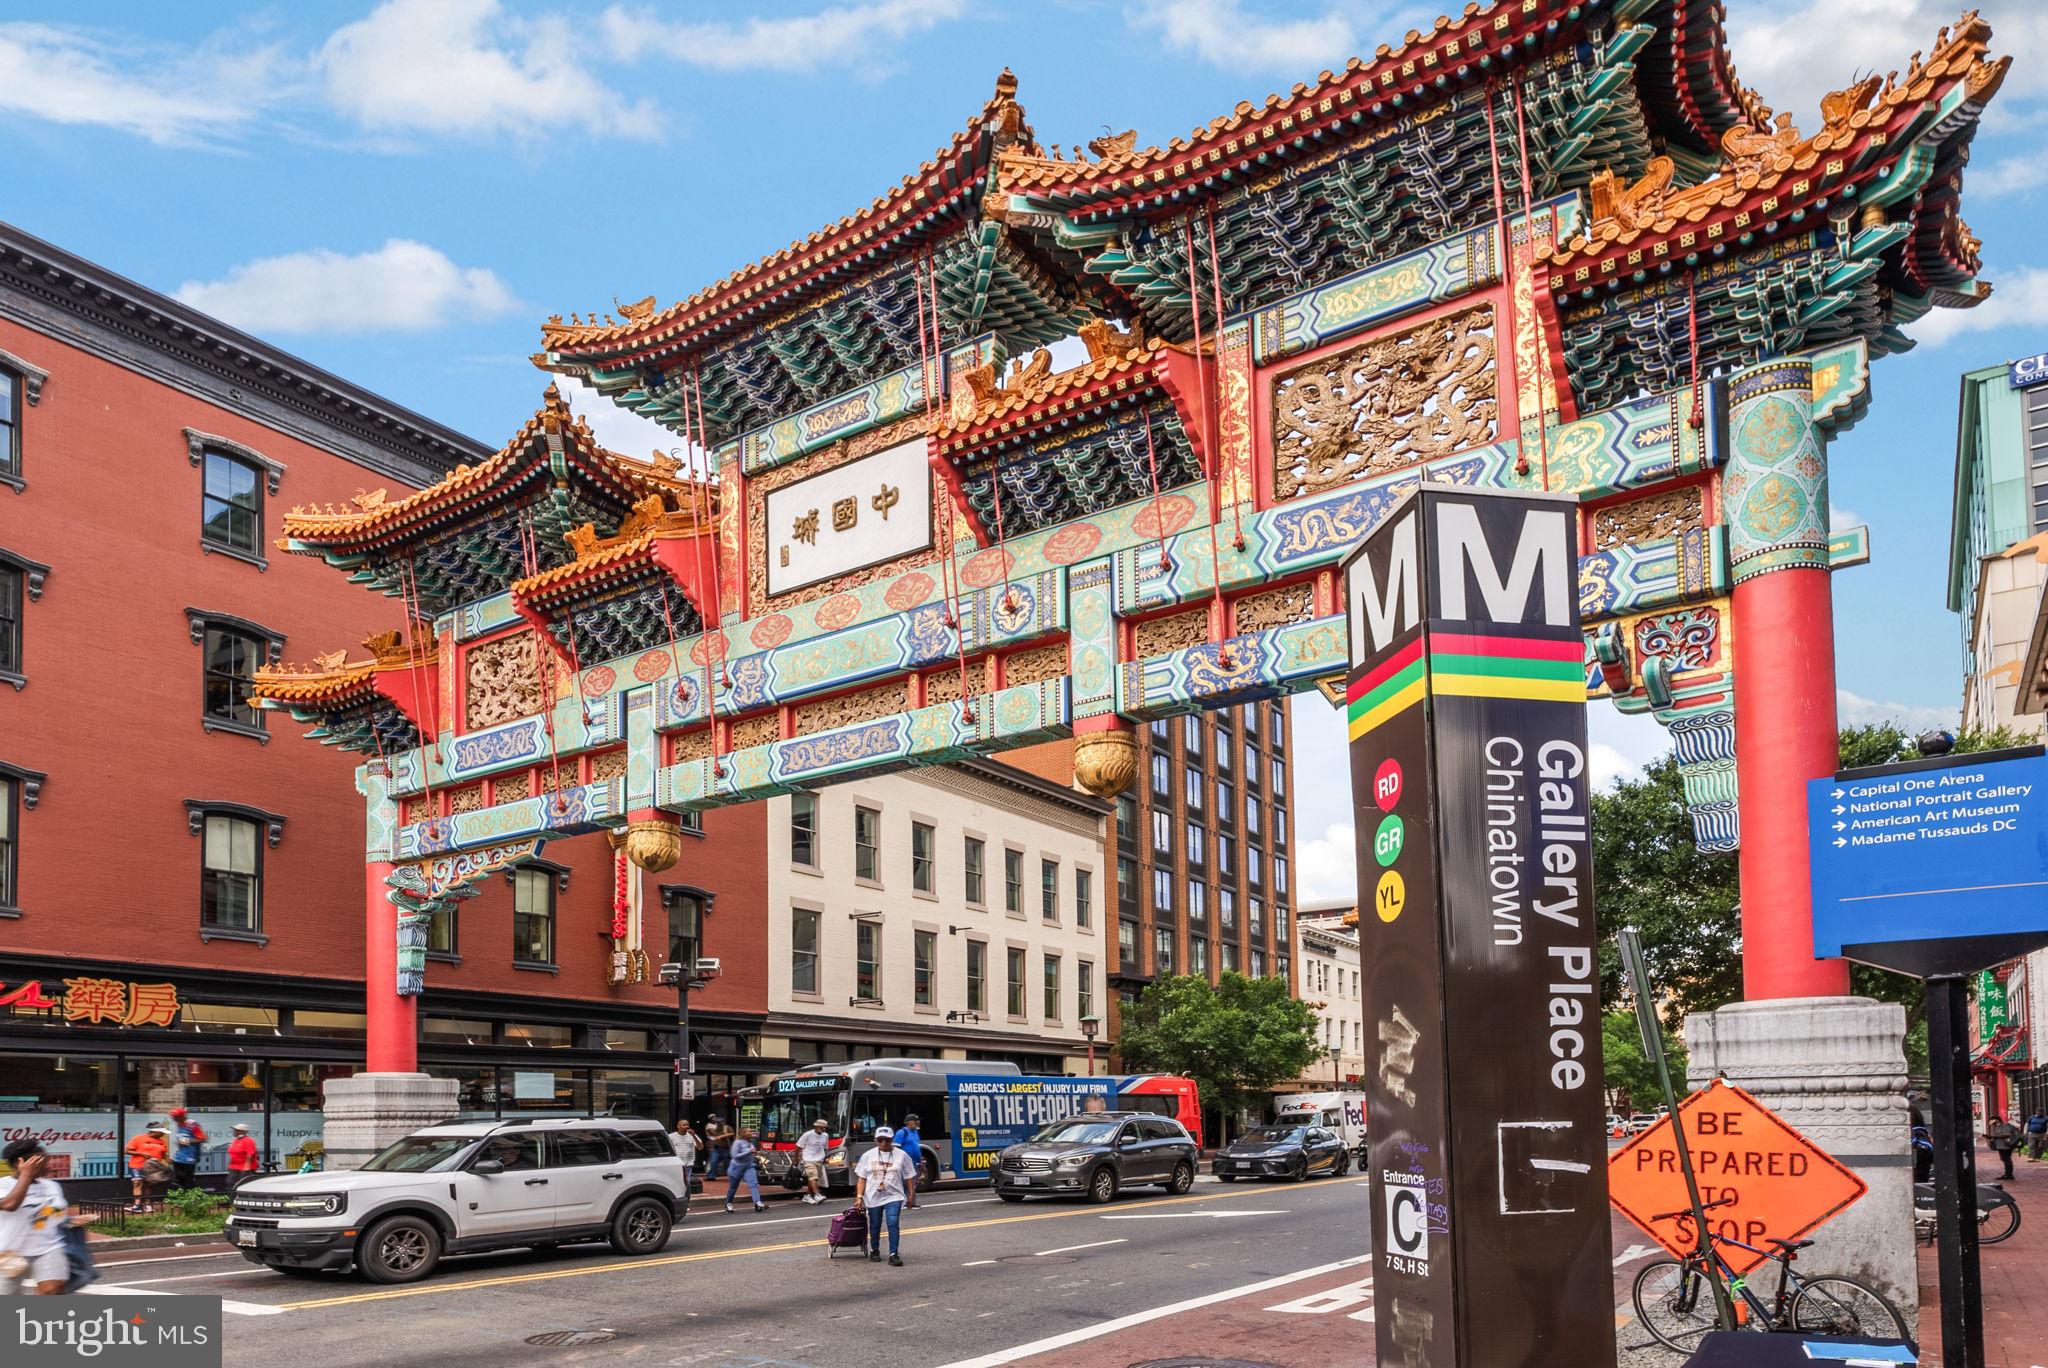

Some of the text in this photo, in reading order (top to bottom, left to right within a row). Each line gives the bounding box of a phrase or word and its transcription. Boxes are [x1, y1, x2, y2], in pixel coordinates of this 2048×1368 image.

[1436, 502, 1570, 626] M
[1350, 509, 1420, 669] M
[1378, 772, 1399, 800] RD
[1849, 773, 1985, 798] Capital One Arena
[1850, 784, 2033, 814] National Portrait Gallery
[1851, 803, 2020, 830] American Art Museum
[1377, 826, 1401, 856] GR
[1485, 737, 1525, 945] Chinatown
[1851, 819, 2017, 847] Madame Tussauds DC
[1379, 885, 1400, 909] YL
[1533, 740, 1592, 1090] Gallery Place
[64, 977, 181, 1027] 藥房
[779, 1079, 796, 1092] D2X
[796, 1080, 818, 1089] GALLERY
[958, 1083, 1108, 1094] AMERICA'S LARGEST INJURY LAW FIRM
[959, 1095, 991, 1126] FOR
[994, 1095, 1025, 1125] THE
[1281, 1102, 1318, 1113] FedEx
[2, 1127, 118, 1146] Walgreens
[277, 1128, 313, 1138] Happy
[1697, 1111, 1743, 1136] BE
[1383, 1169, 1425, 1186] Entrance
[233, 1199, 282, 1208] BRONCO
[1700, 1186, 1740, 1211] TO
[1392, 1189, 1422, 1252] C
[1386, 1255, 1429, 1277] 7 St, H St
